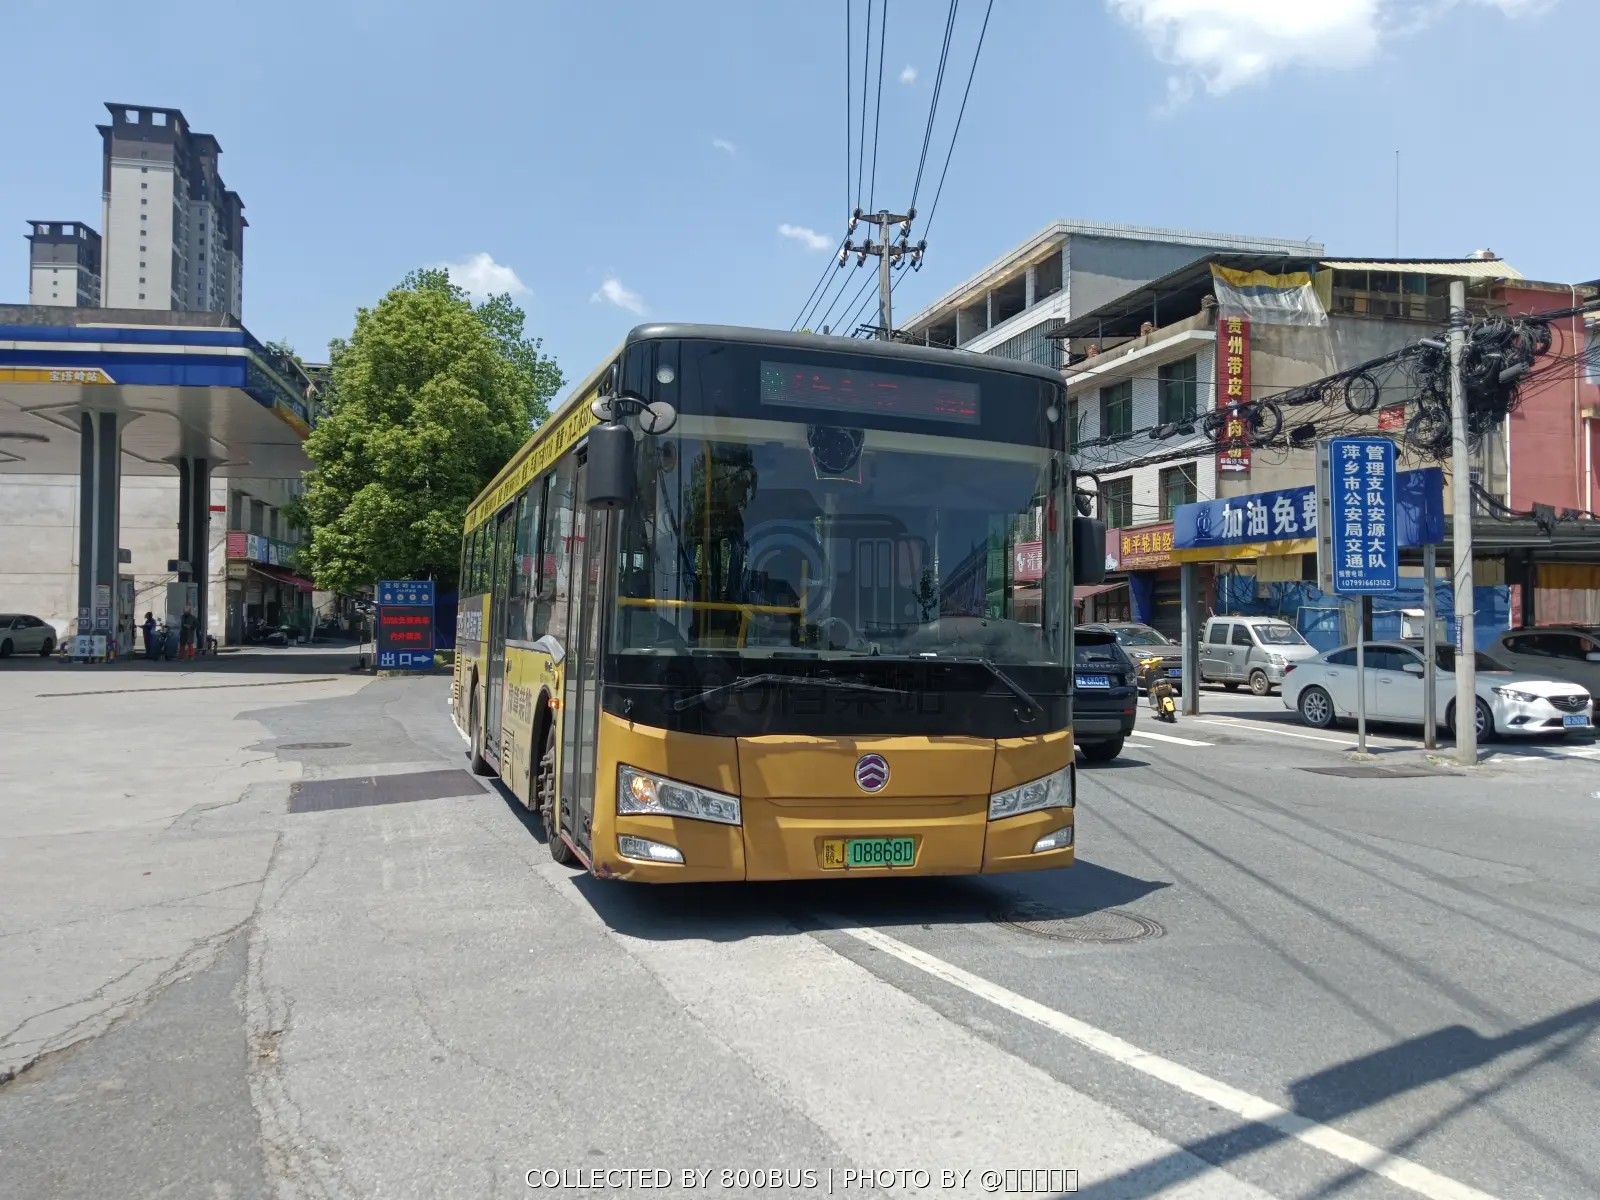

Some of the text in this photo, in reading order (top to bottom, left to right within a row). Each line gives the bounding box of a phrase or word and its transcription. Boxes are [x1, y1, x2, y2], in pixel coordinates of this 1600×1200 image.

[1342, 445, 1364, 568] 萍乡市公安局交通
[1366, 445, 1387, 568] 管理支队安源大队
[1122, 531, 1175, 556] 和平轮胎经
[381, 652, 412, 667] 出口
[853, 842, 912, 863] 08868D
